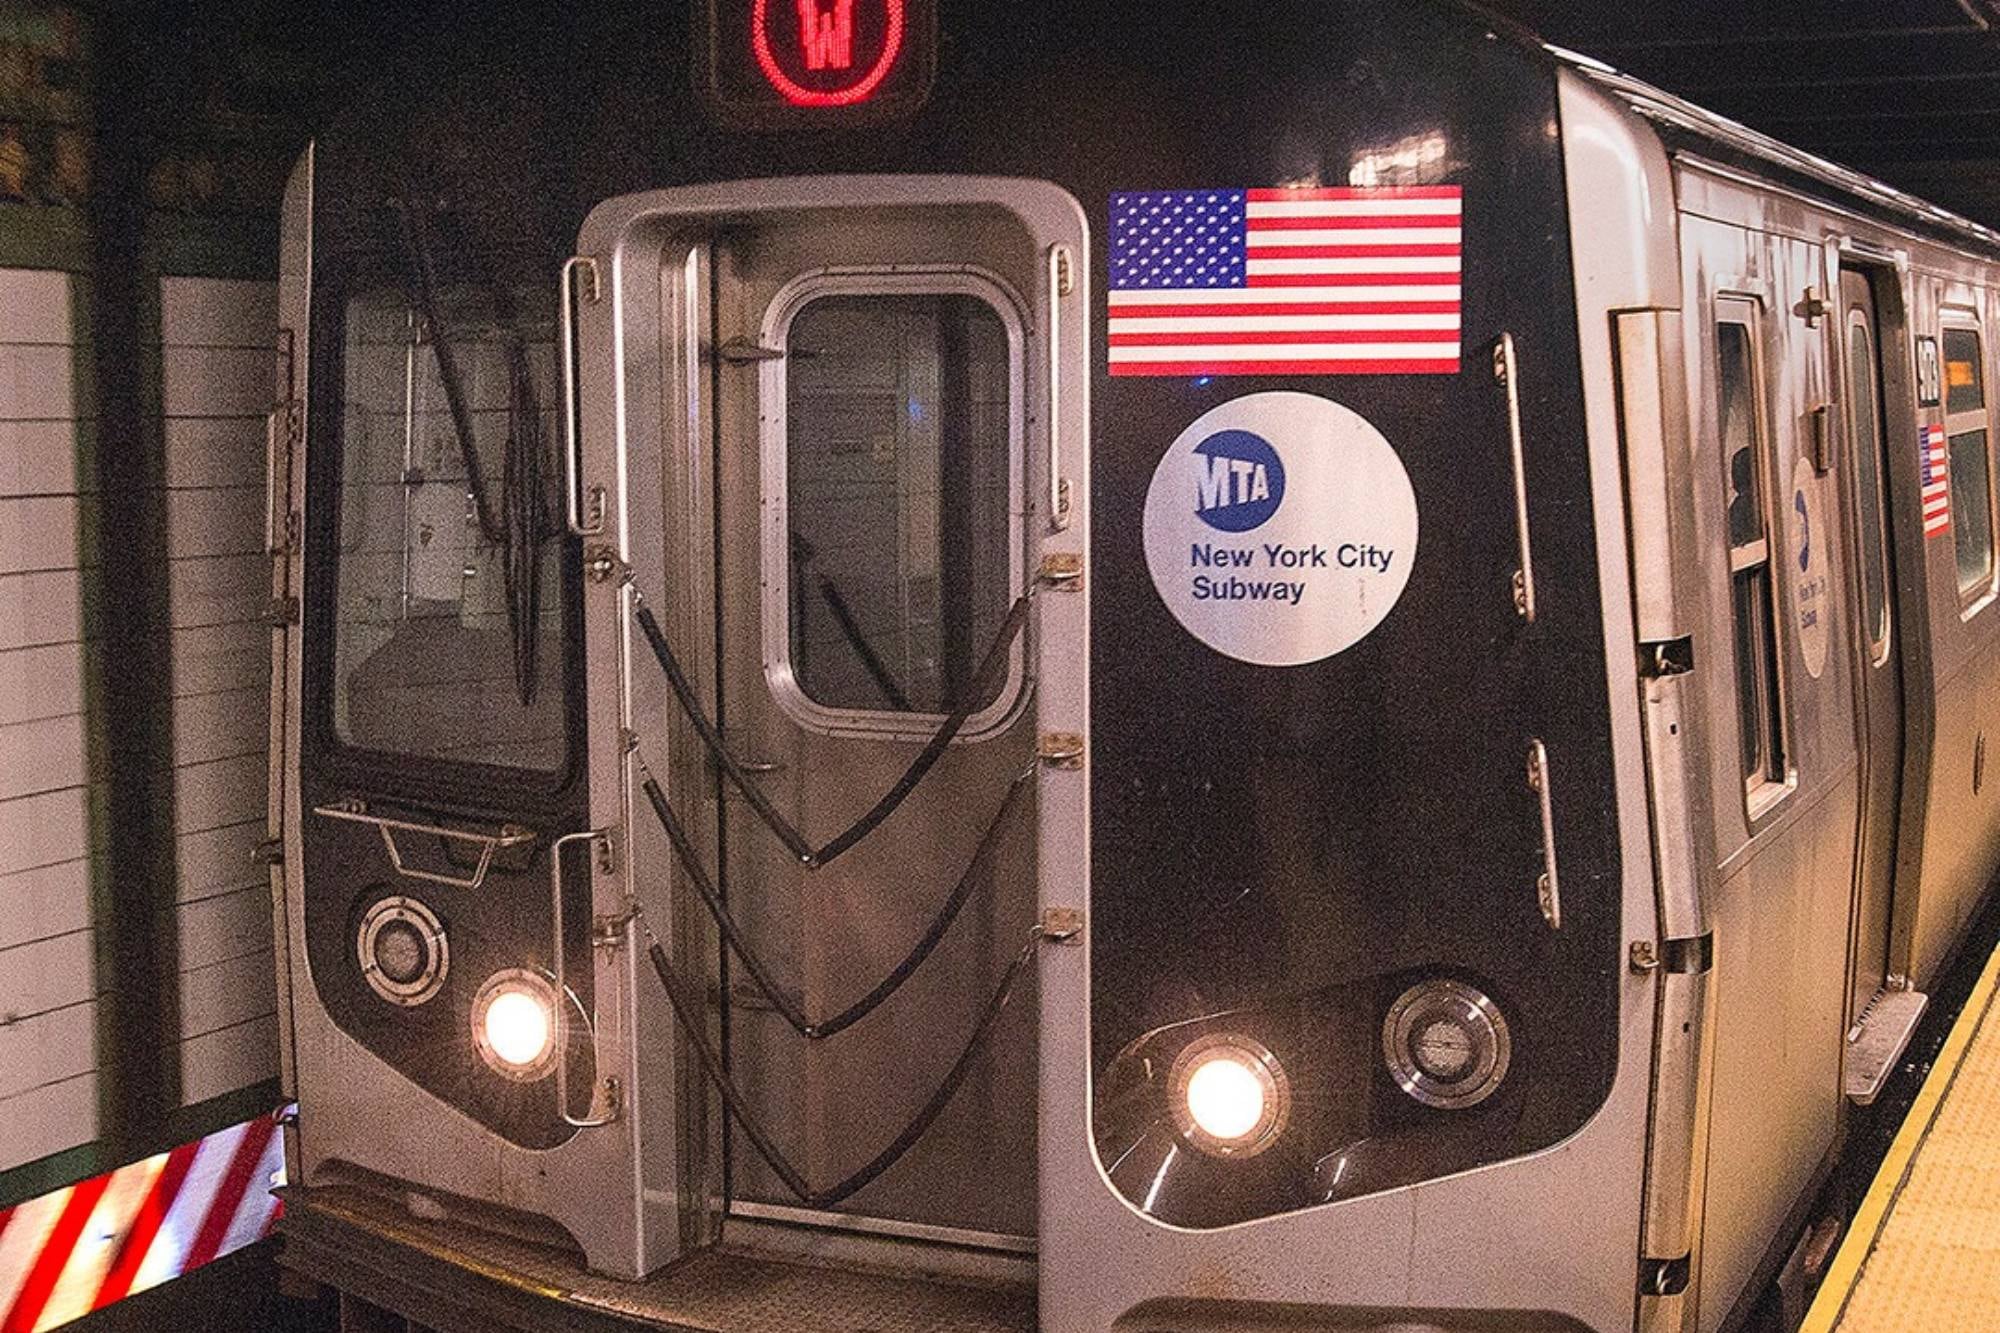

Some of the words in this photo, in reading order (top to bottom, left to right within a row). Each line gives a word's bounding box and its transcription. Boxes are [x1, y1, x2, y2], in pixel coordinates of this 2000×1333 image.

[797, 0, 852, 70] W
[1193, 452, 1269, 511] MTA
[1191, 543, 1253, 567] New
[1265, 543, 1326, 567] York
[1336, 543, 1393, 572] City
[1192, 576, 1305, 605] Subway
